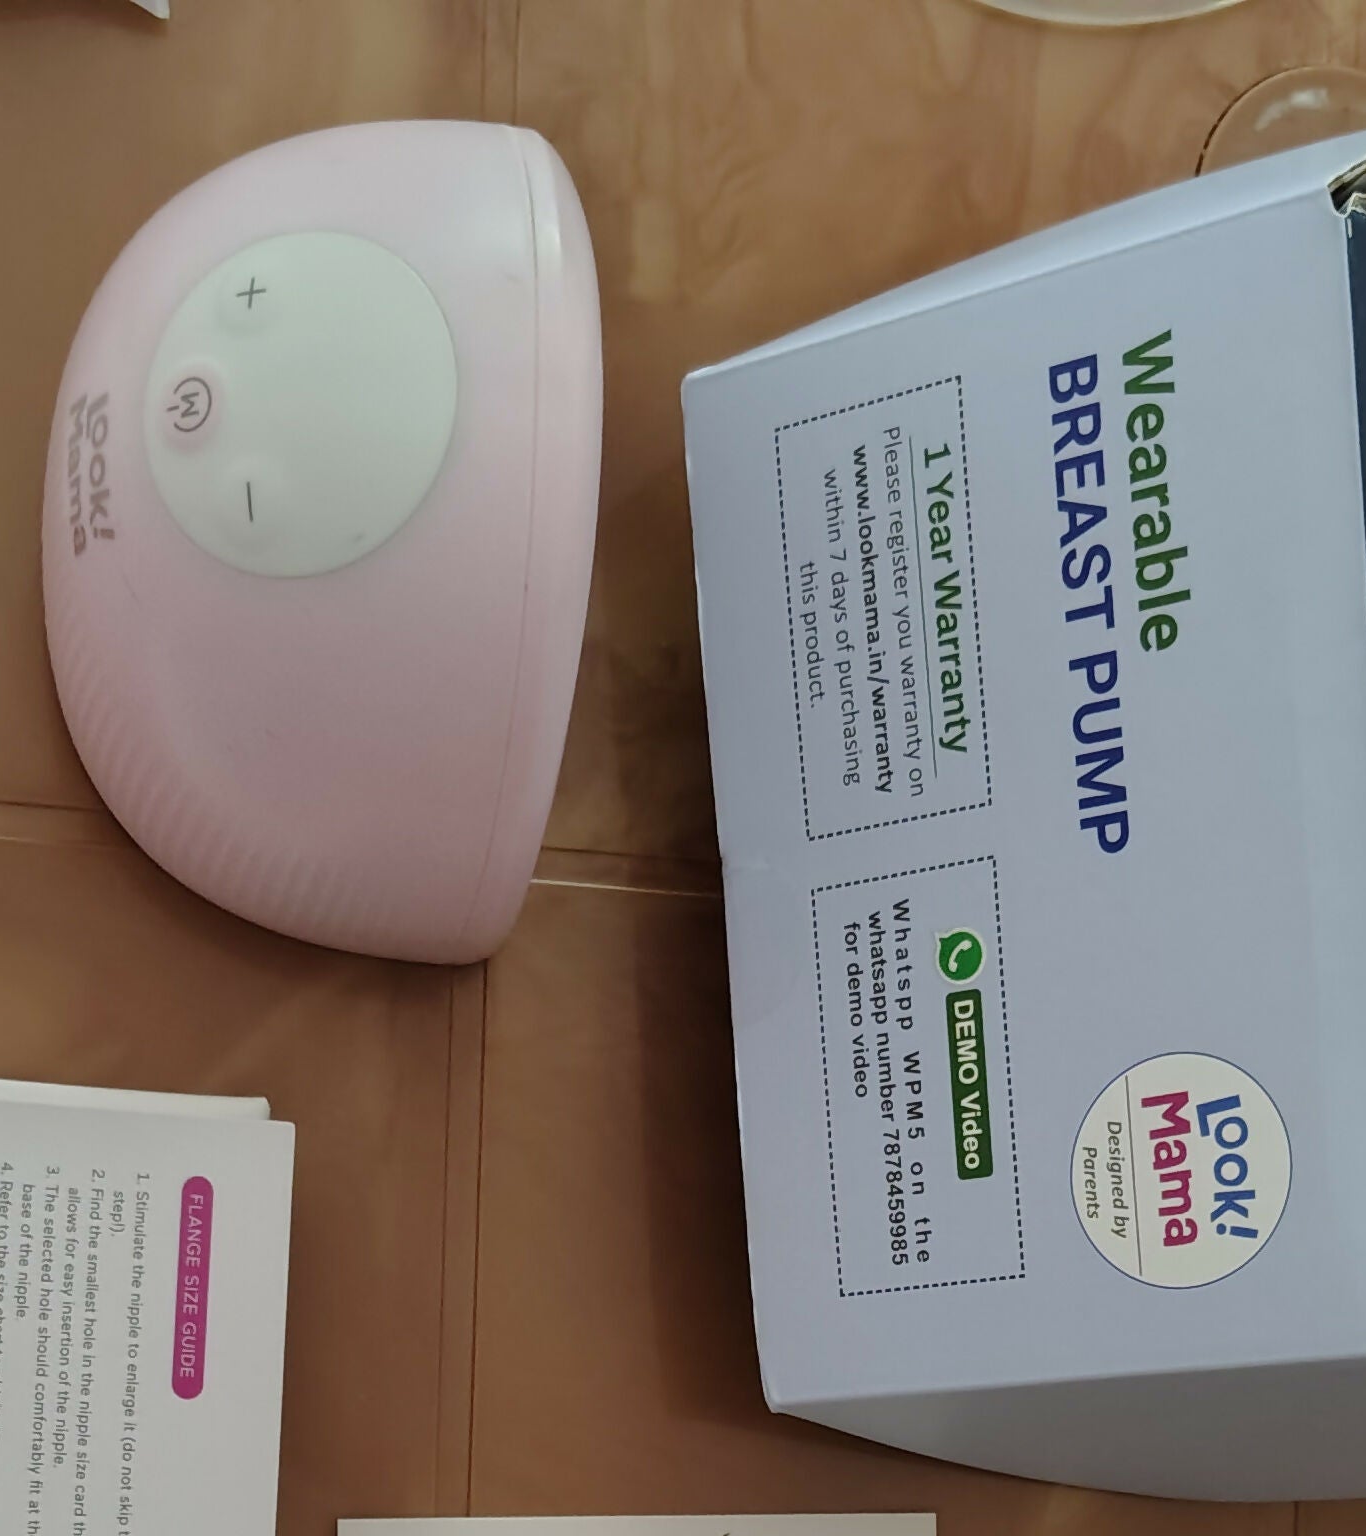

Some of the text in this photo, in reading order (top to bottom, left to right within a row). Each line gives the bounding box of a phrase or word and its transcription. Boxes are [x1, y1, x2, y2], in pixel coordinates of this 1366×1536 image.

[882, 426, 924, 797] Please register you warranty on
[923, 442, 971, 753] 1 Year Warranty
[1048, 353, 1129, 854] BREAST PUMP
[1121, 328, 1191, 652] Wearable
[798, 560, 825, 708] this product.
[823, 468, 862, 786] within 7 days of purchasing
[852, 444, 894, 793] www.lookmama.in/warranty
[843, 921, 870, 1098] for demo video
[867, 910, 909, 1265] whatsapp number 7878459985
[891, 898, 932, 1262] Whatspp WPM5 on the
[953, 998, 983, 1169] DEMO Video
[179, 1193, 204, 1377] FLANGE SIZE GUIDE
[1081, 1146, 1100, 1218] Parents
[1105, 1120, 1130, 1238] Designed by
[1140, 1090, 1198, 1247] Mama
[1195, 1093, 1259, 1239] Look!
